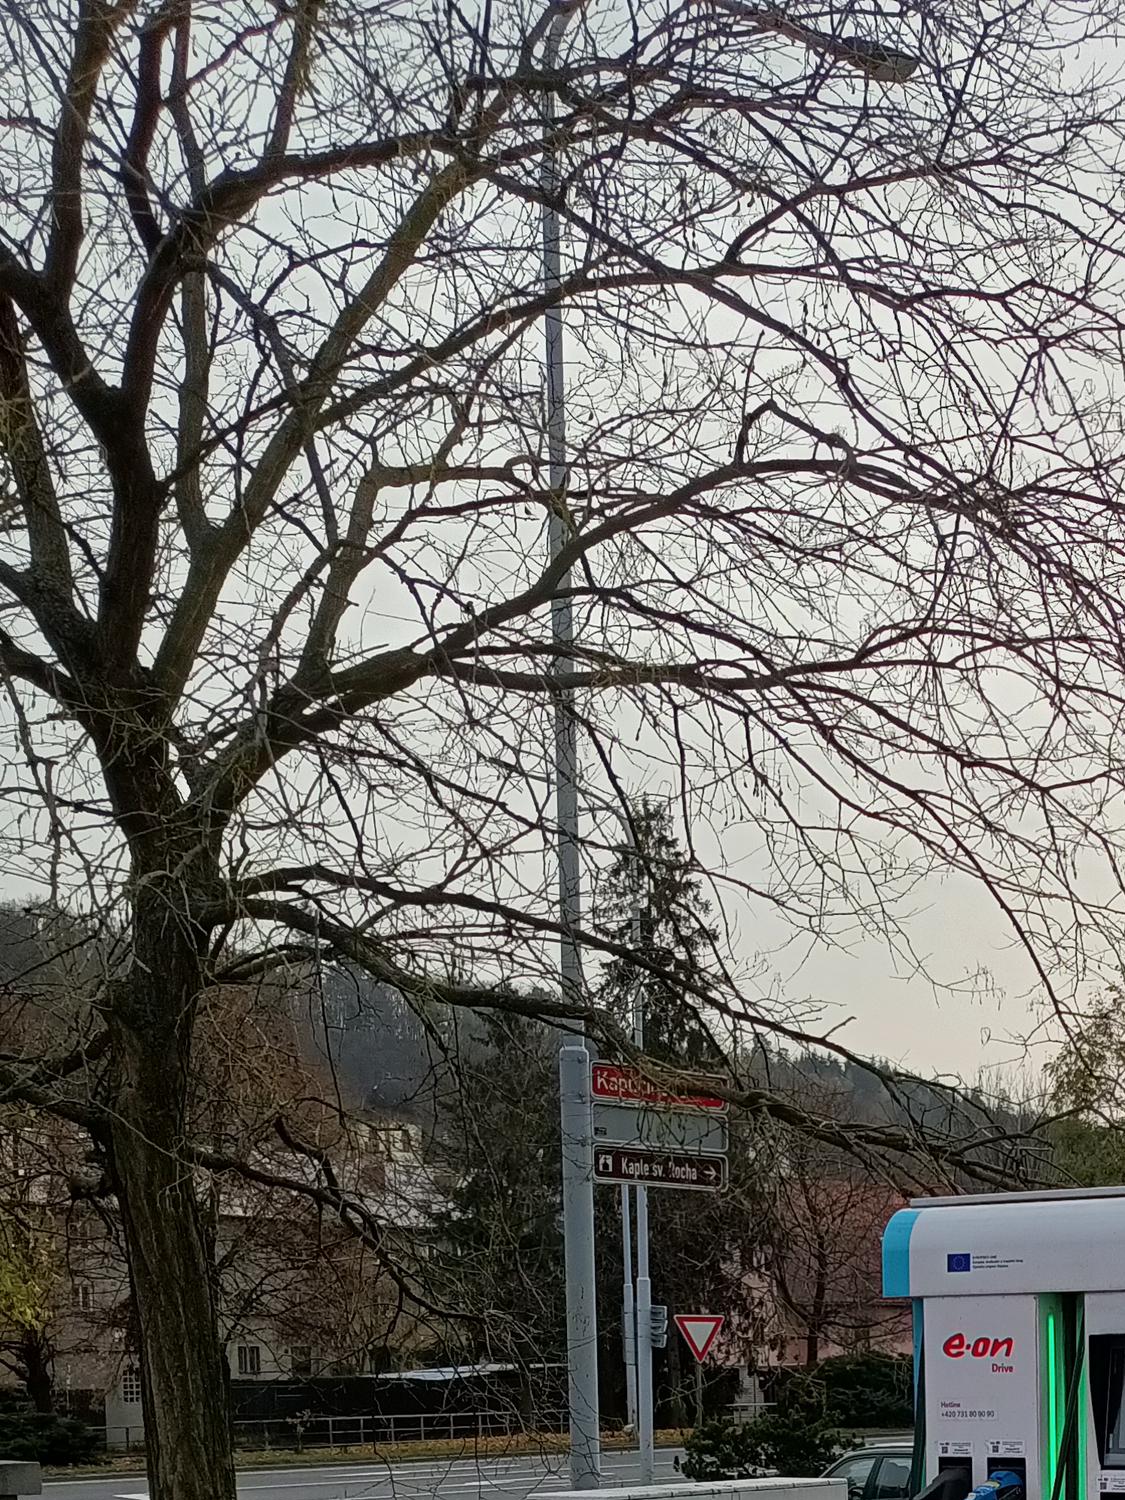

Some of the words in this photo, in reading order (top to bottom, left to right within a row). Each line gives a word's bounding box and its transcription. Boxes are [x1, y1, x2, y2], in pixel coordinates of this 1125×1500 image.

[621, 1157, 650, 1178] Kaple
[652, 1165, 666, 1177] sv.
[991, 1363, 1014, 1373] Drive
